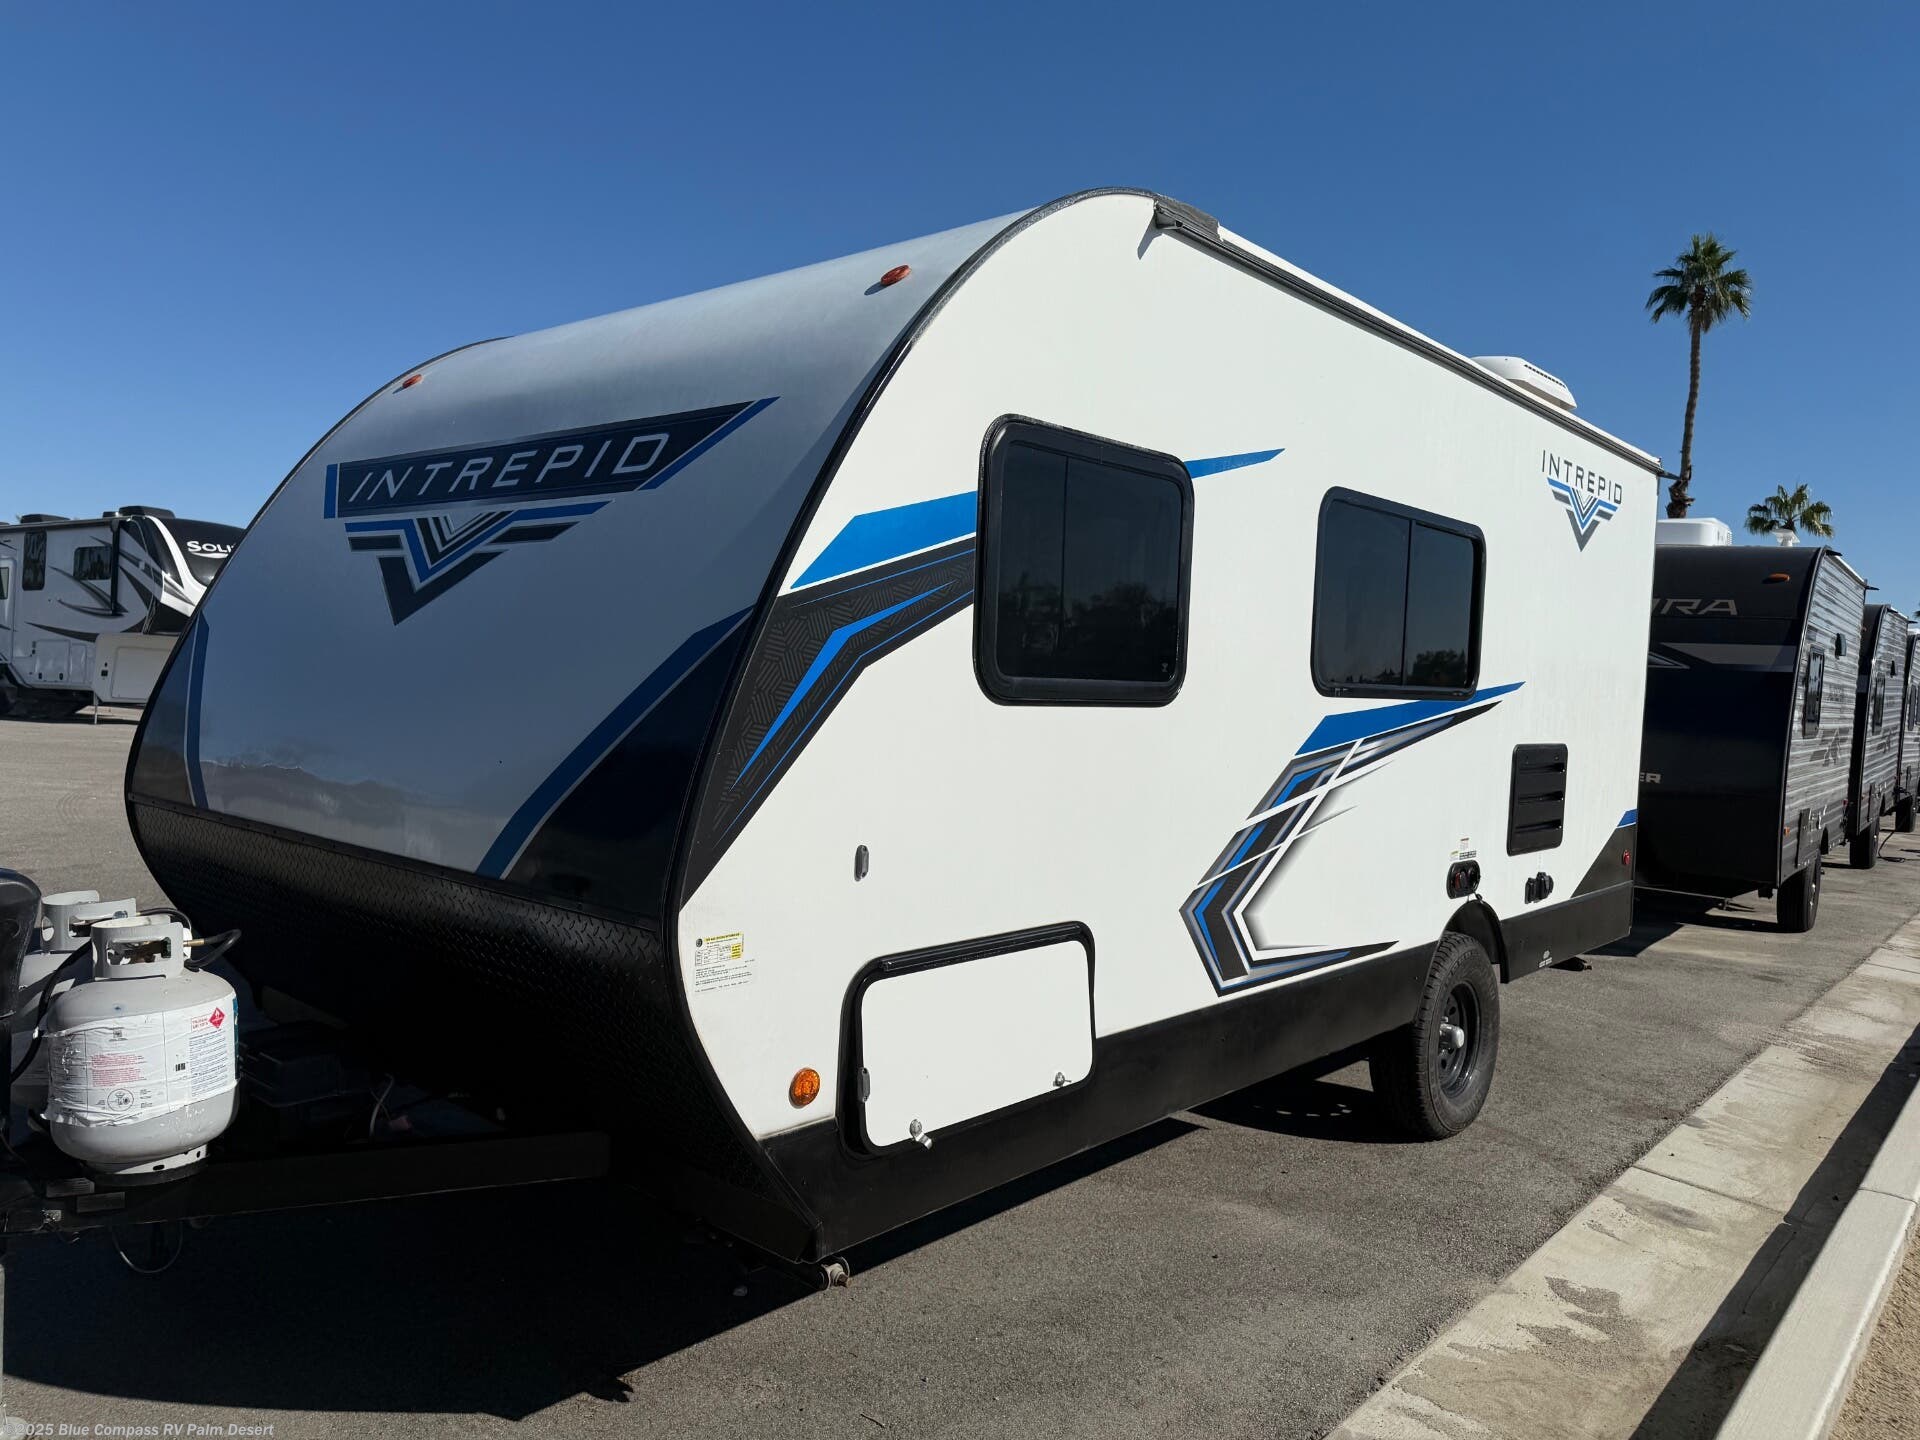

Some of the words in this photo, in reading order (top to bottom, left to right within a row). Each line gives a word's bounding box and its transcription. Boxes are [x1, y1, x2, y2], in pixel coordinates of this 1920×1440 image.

[348, 432, 670, 503] INTREPID
[1541, 449, 1623, 505] INTREPID
[186, 540, 237, 553] SOLI
